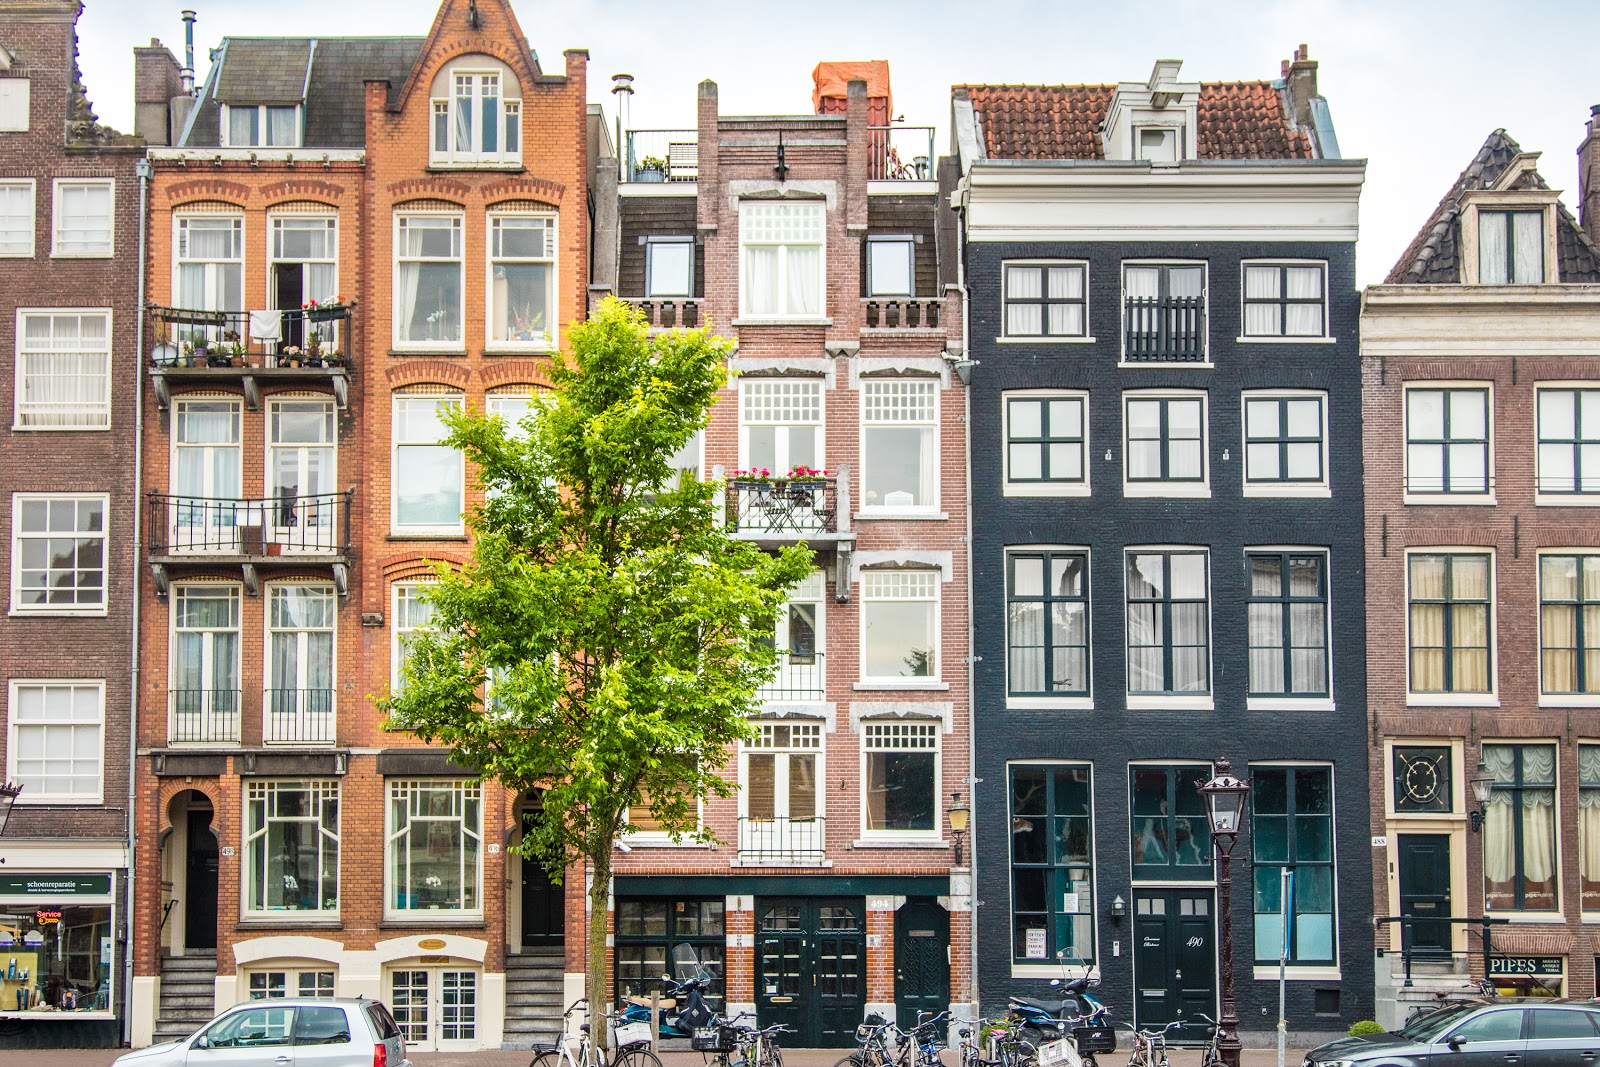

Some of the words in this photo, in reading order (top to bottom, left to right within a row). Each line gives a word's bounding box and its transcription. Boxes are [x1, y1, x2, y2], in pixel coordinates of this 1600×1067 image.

[27, 881, 76, 889] schoenreparatie
[870, 899, 889, 908] 494
[1186, 936, 1203, 947] 490
[1490, 959, 1536, 972] PIPES
